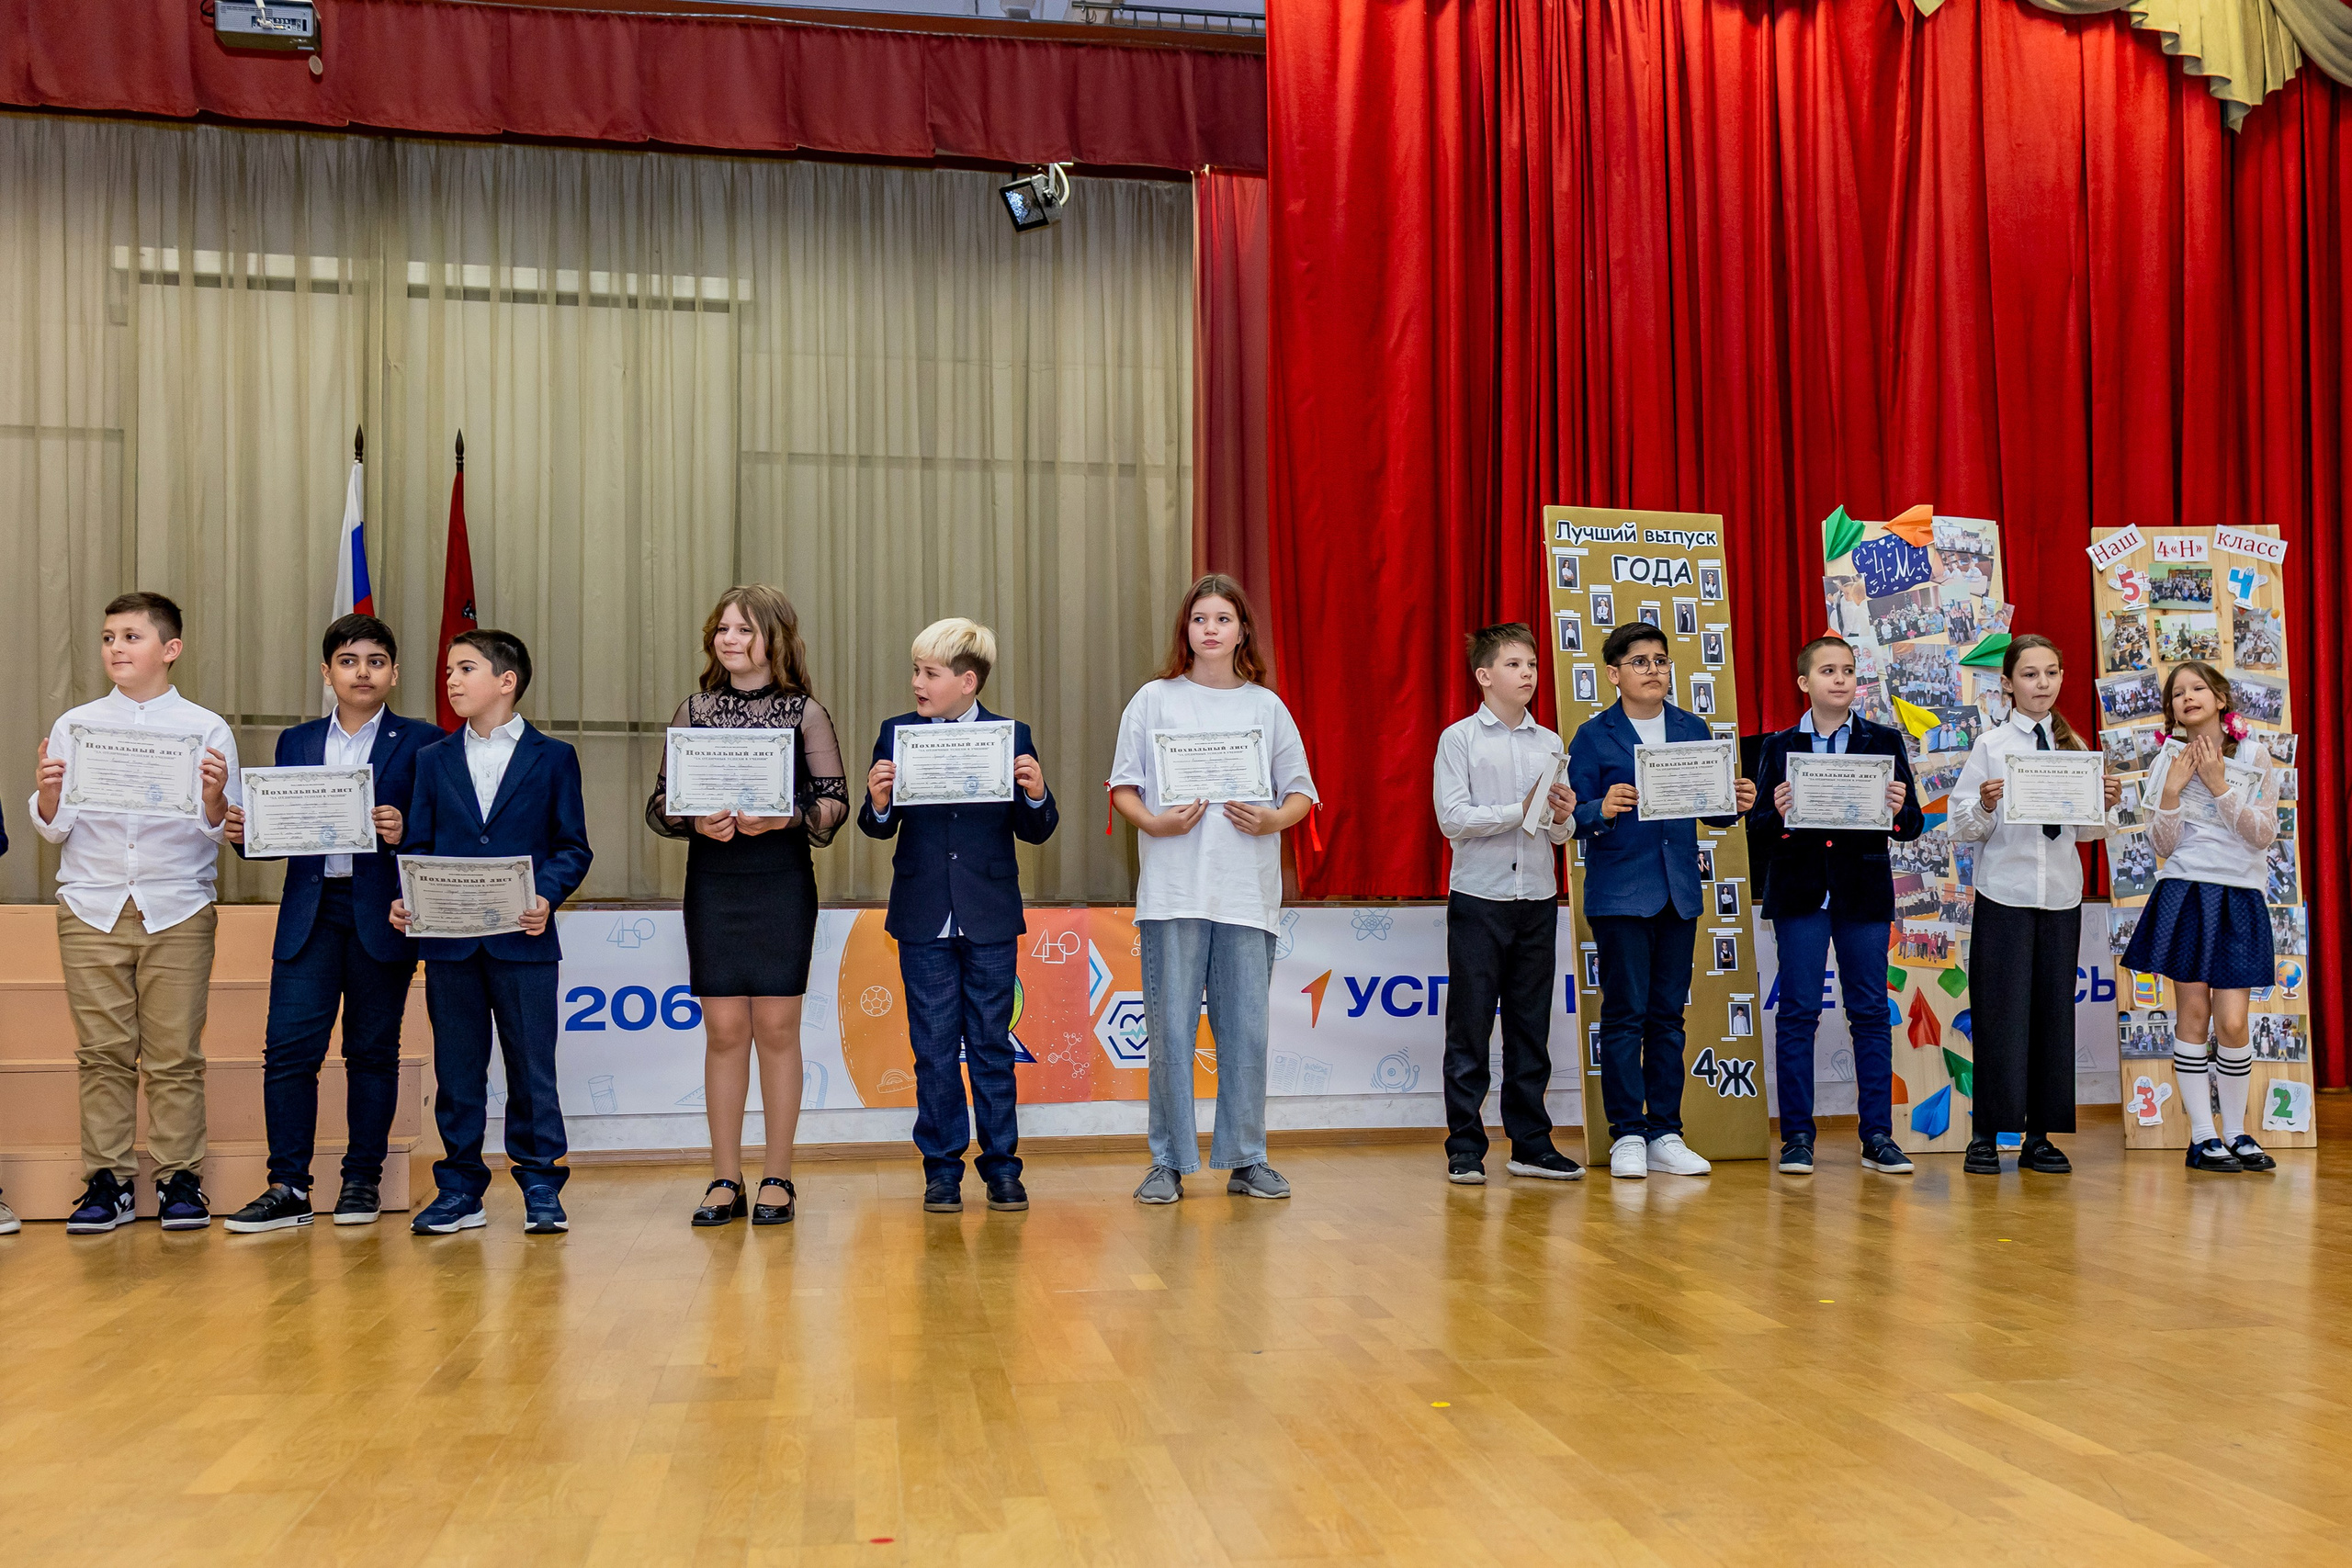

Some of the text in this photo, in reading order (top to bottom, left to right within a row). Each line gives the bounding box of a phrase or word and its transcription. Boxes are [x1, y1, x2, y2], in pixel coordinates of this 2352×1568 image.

[1556, 521, 1716, 549] Лучший выпуск
[2093, 532, 2139, 564] Наш
[2217, 532, 2278, 558] класс
[1613, 556, 1692, 586] ГОДА
[564, 985, 702, 1032] 206
[2272, 1088, 2293, 1119] 2
